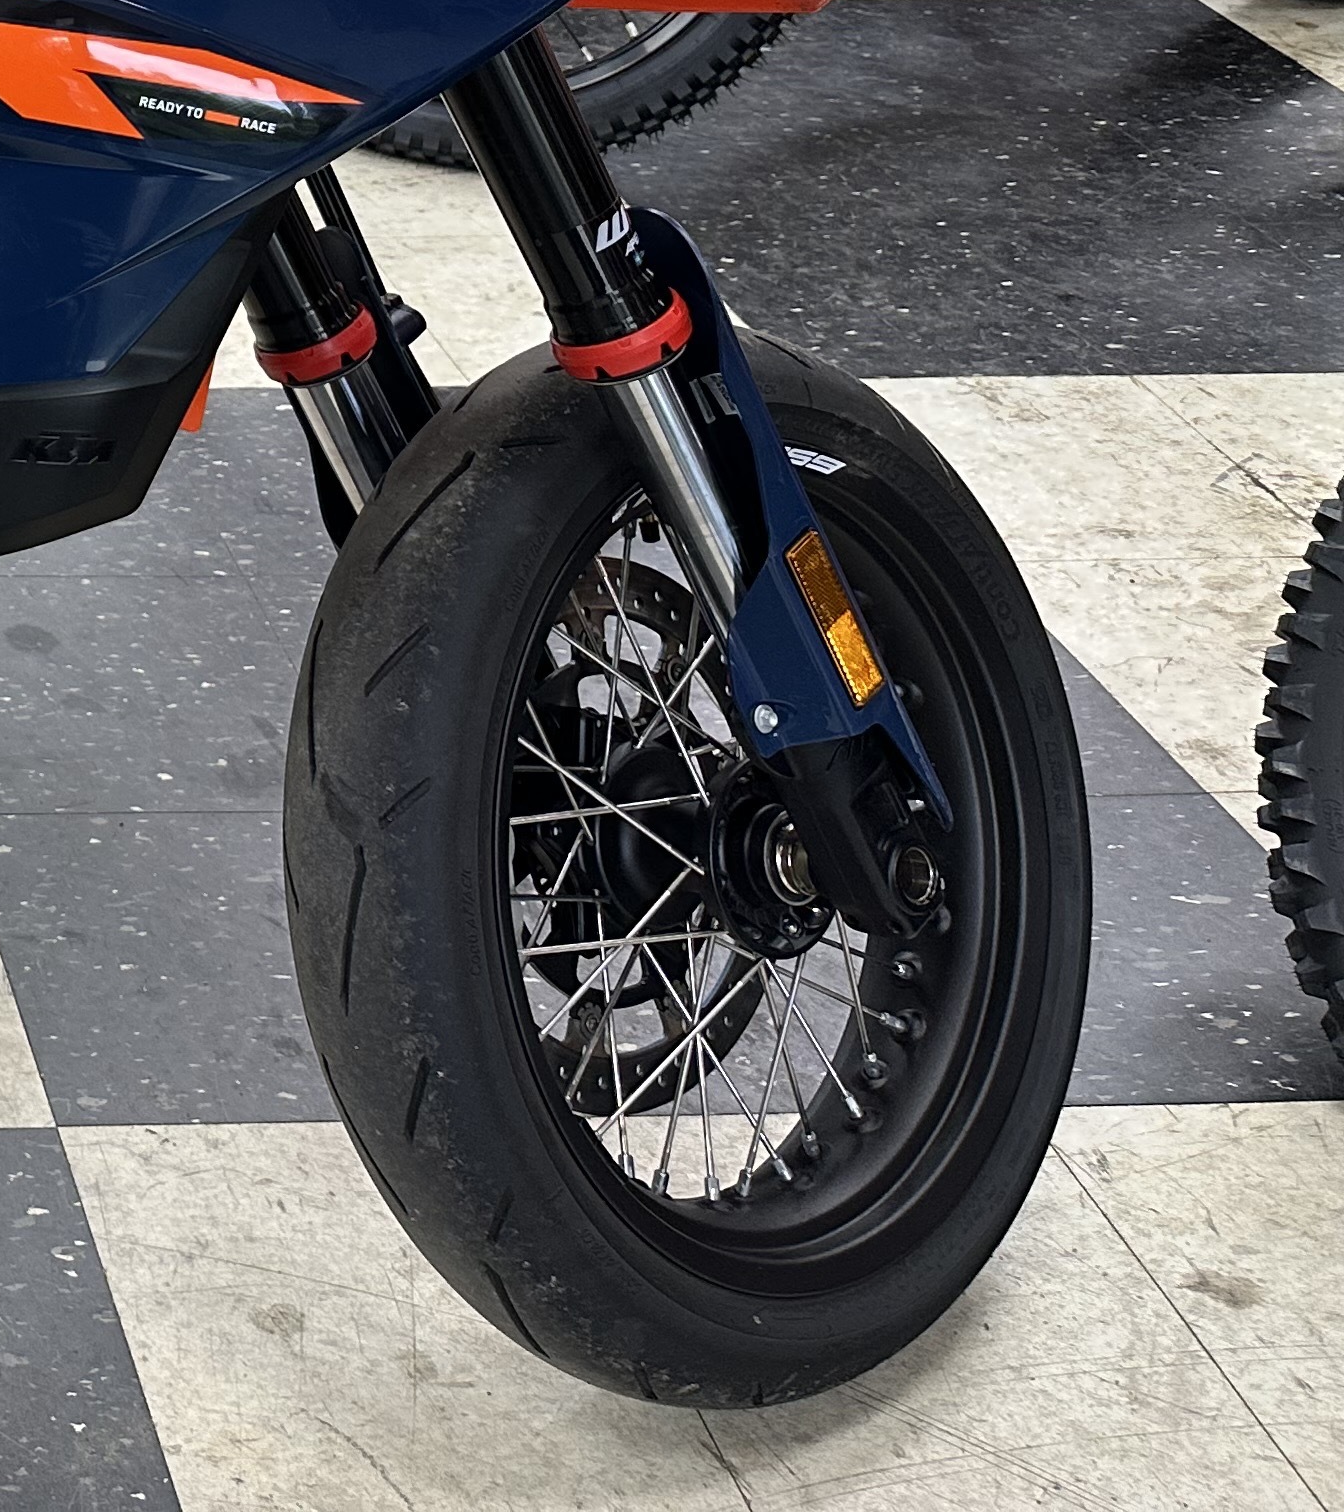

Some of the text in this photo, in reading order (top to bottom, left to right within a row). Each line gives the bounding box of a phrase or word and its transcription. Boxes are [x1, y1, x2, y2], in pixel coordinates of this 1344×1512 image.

[139, 96, 277, 135] READY TO RACE
[595, 203, 630, 253] W
